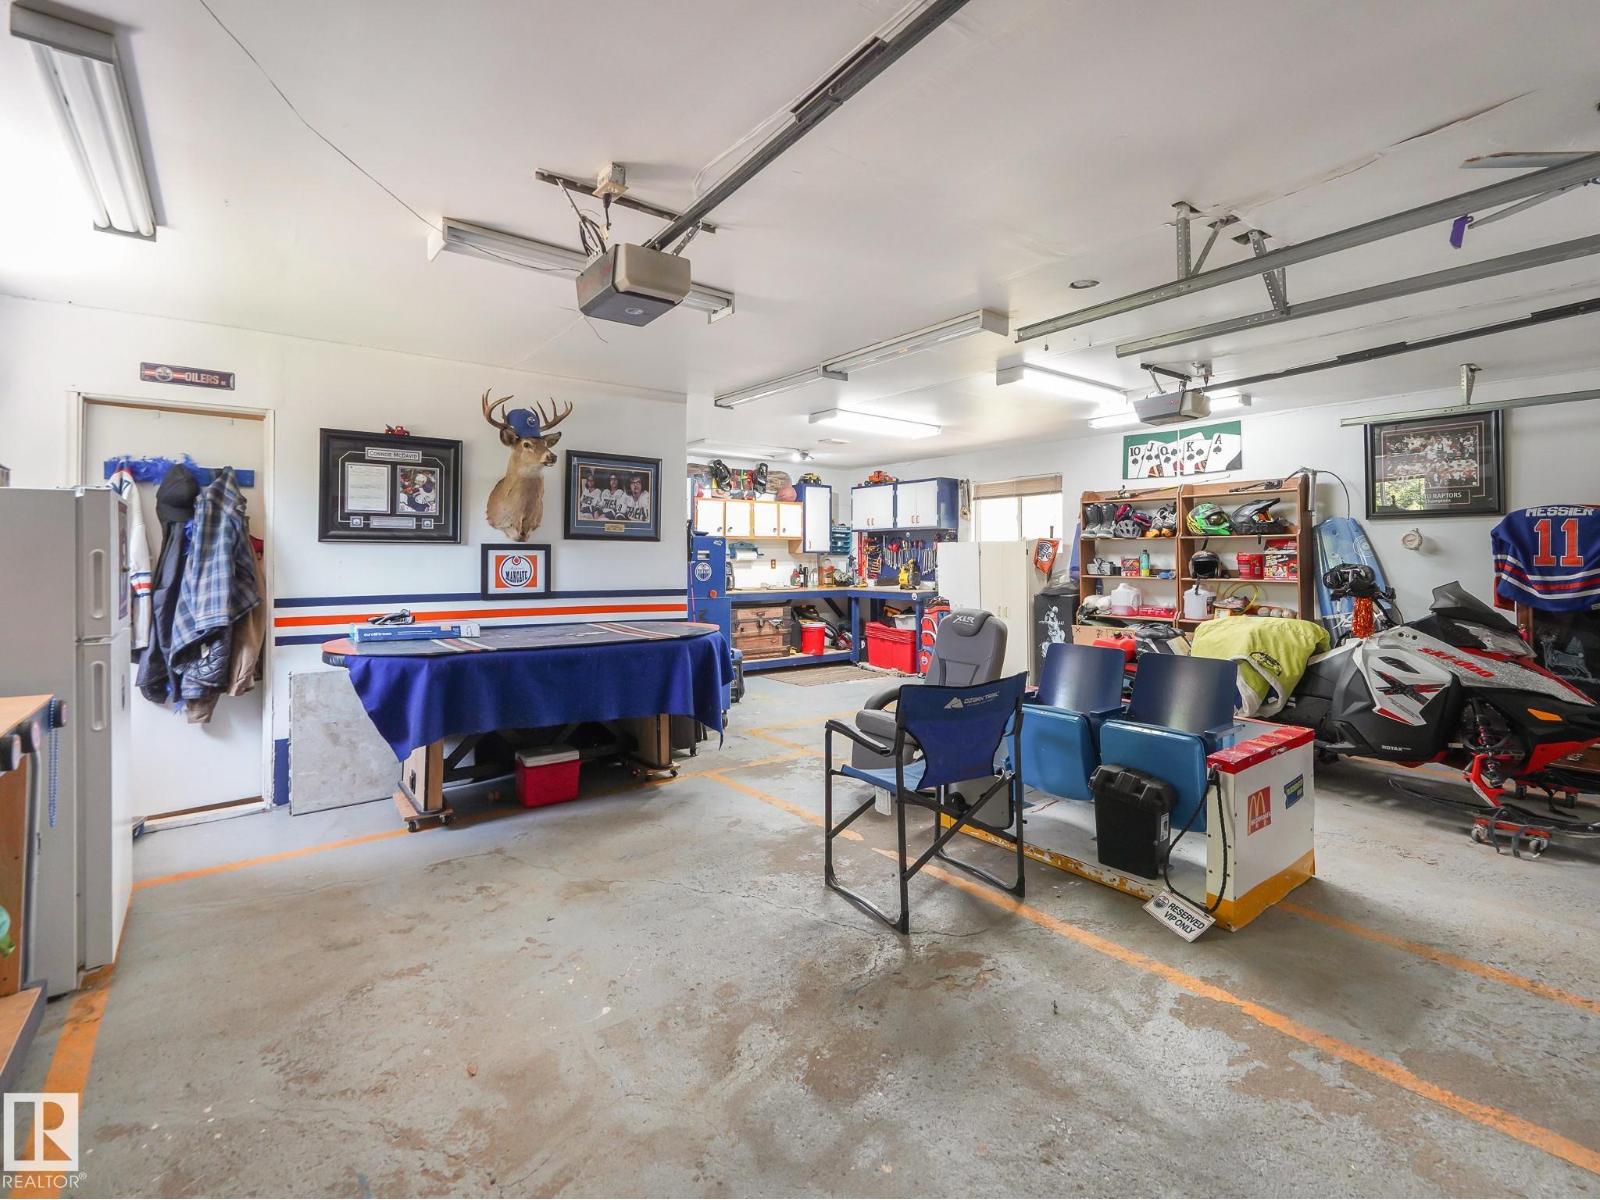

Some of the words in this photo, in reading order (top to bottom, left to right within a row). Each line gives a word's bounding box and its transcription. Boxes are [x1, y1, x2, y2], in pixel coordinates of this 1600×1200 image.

[185, 372, 219, 385] OILERS
[1160, 446, 1170, 456] Q
[1186, 441, 1194, 452] K
[1214, 434, 1222, 445] A
[1432, 491, 1462, 499] RAPTORS
[1533, 518, 1584, 567] 11
[1164, 911, 1178, 922] VIP
[1174, 919, 1196, 934] ONLY
[1168, 902, 1205, 929] RESERVED
